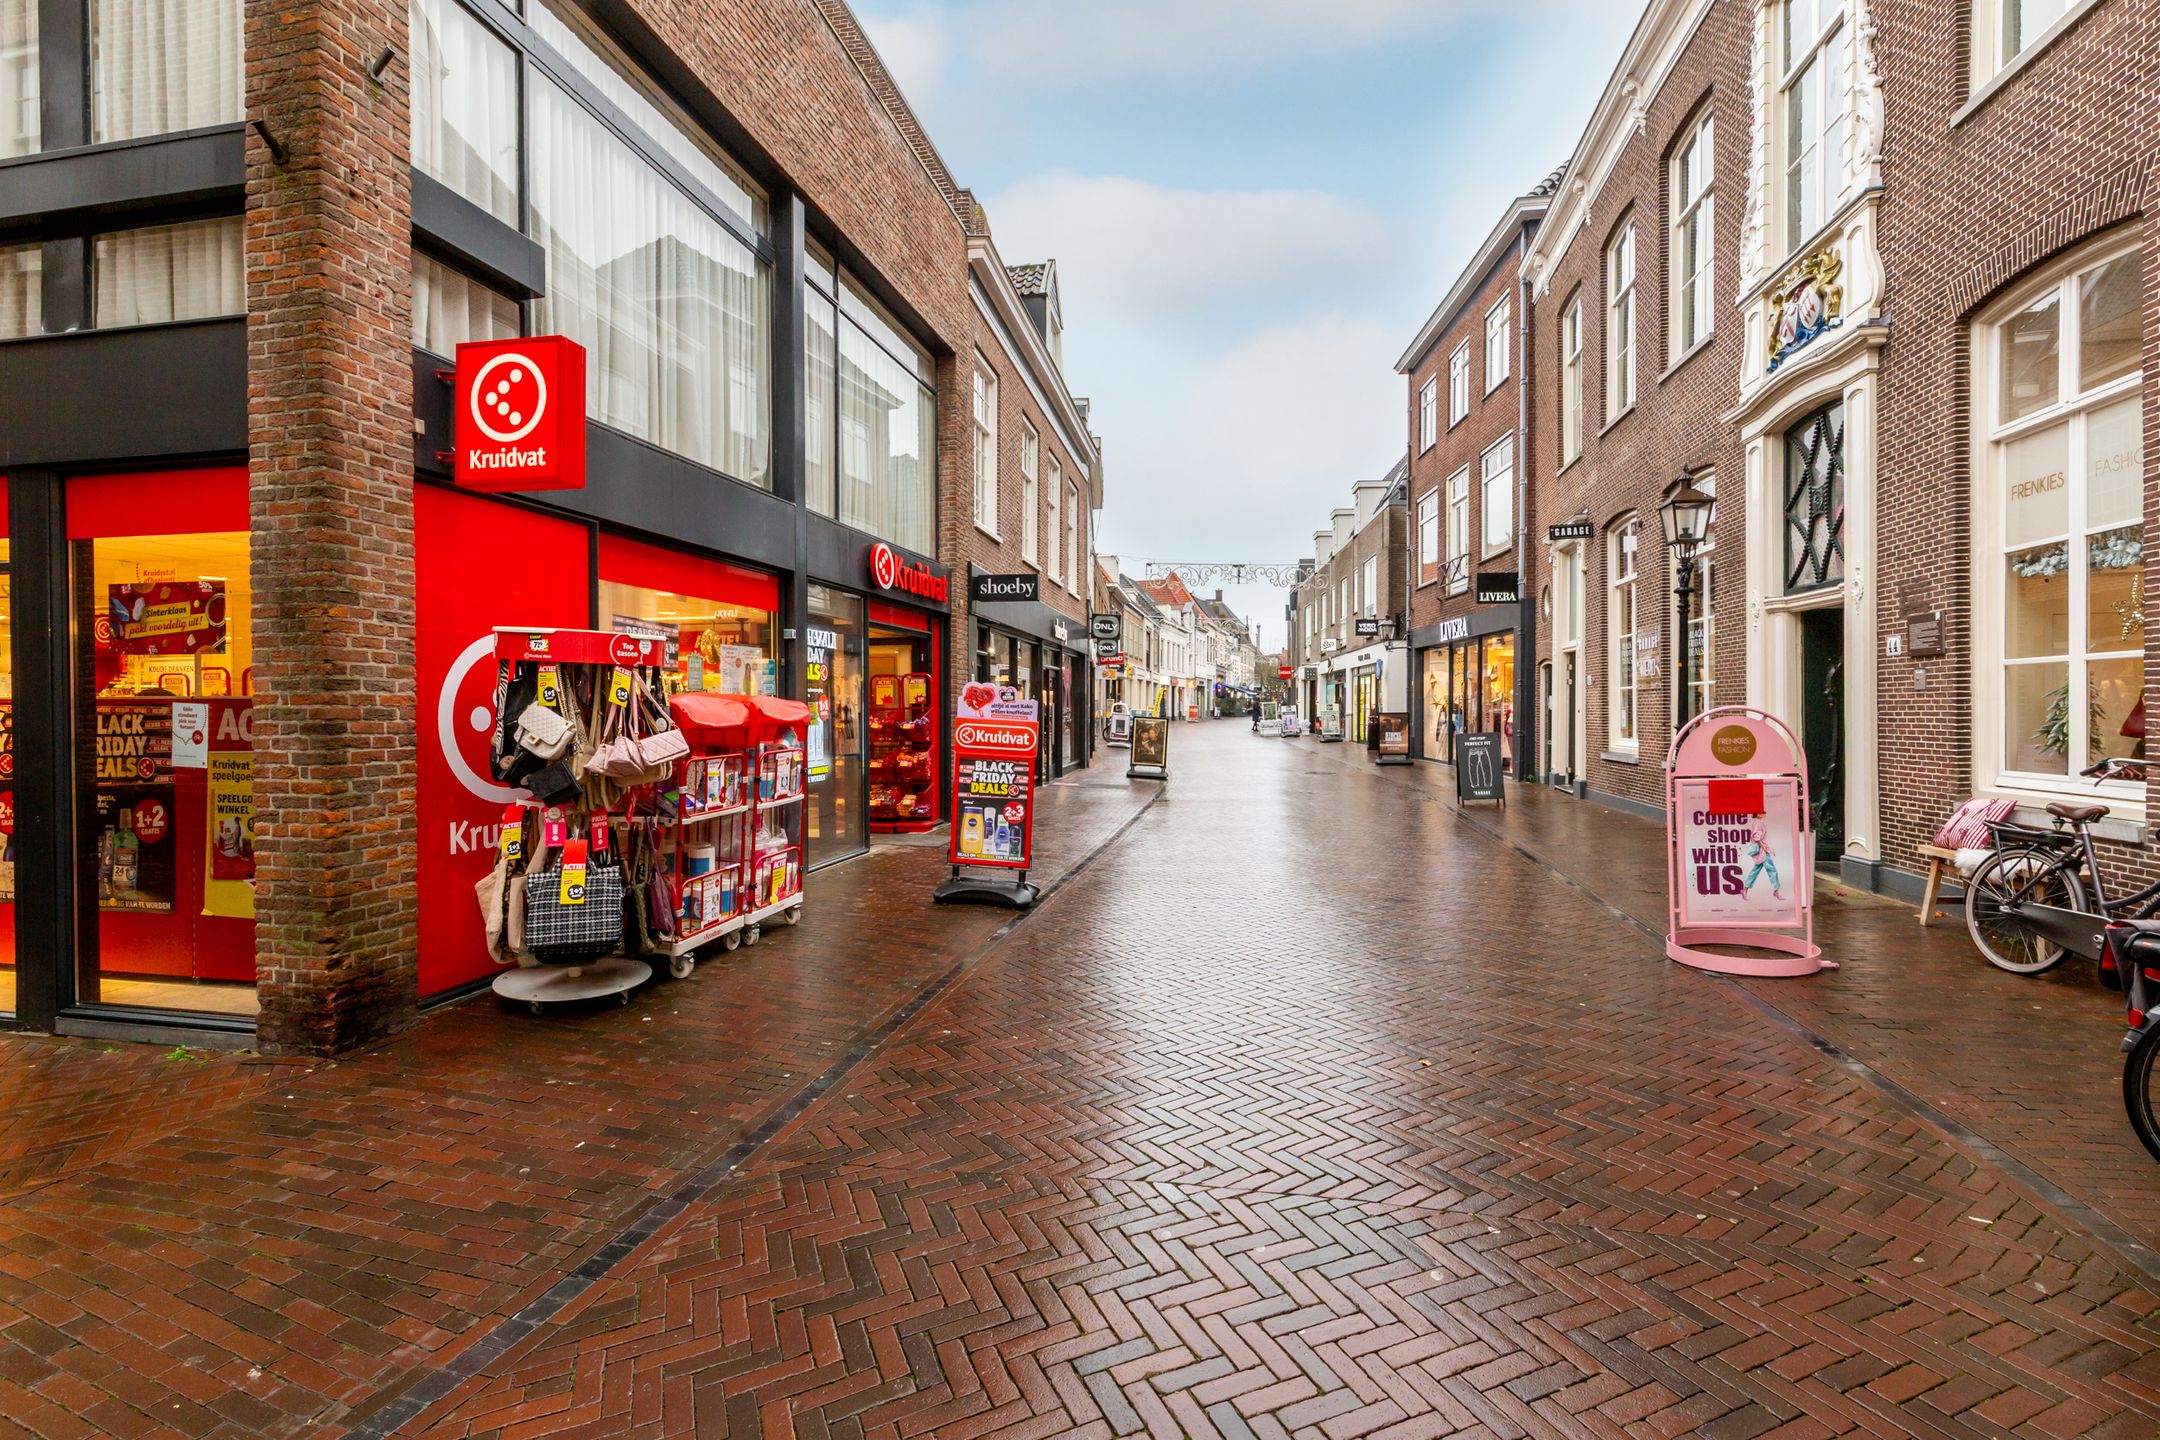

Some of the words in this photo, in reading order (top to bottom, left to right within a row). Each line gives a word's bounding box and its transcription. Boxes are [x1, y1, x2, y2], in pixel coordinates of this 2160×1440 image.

[469, 446, 546, 469] Kruidvat
[2010, 471, 2064, 501] FRENKIES
[894, 554, 948, 603] Kruidvat
[979, 578, 1035, 597] shoeby
[1479, 592, 1516, 602] LIVERA
[145, 606, 187, 618] Sinterklaas
[149, 618, 186, 631] voordelig
[1094, 623, 1118, 631] ONLY
[1439, 616, 1468, 642] LIVERA
[616, 646, 639, 658] tassen
[622, 642, 634, 652] Top
[807, 647, 825, 664] DAY
[614, 666, 632, 677] ACTIE!
[543, 689, 556, 697] 1+1
[617, 689, 628, 698] 1+1
[97, 714, 145, 735] LACK
[216, 708, 253, 742] AC
[976, 730, 1030, 745] Kruidvat
[1717, 737, 1750, 745] FRENKIES
[96, 736, 147, 757] RIDAY
[1718, 745, 1750, 753] FASHION
[96, 757, 137, 778] EALS
[212, 760, 250, 770] Kruidvat
[974, 760, 1014, 773] BLACK
[972, 771, 1016, 784] FRIDAY
[970, 782, 1009, 795] DEALS
[217, 794, 253, 804] SPEELGO
[217, 805, 250, 814] WINKEL
[1004, 805, 1024, 817] 2+3
[136, 805, 164, 828] 1+2
[503, 821, 522, 830] ACTIE!
[140, 828, 160, 836] GRATIS
[449, 820, 500, 855] Kru
[1707, 827, 1751, 844] shop
[508, 842, 521, 852] 1+1
[1692, 845, 1738, 864] with
[114, 866, 125, 875] 24
[563, 863, 586, 871] ACTIE!
[1696, 865, 1744, 895] us
[568, 887, 585, 896] 1+1
[125, 900, 138, 908] VAN
[145, 902, 171, 910] WORDEN
